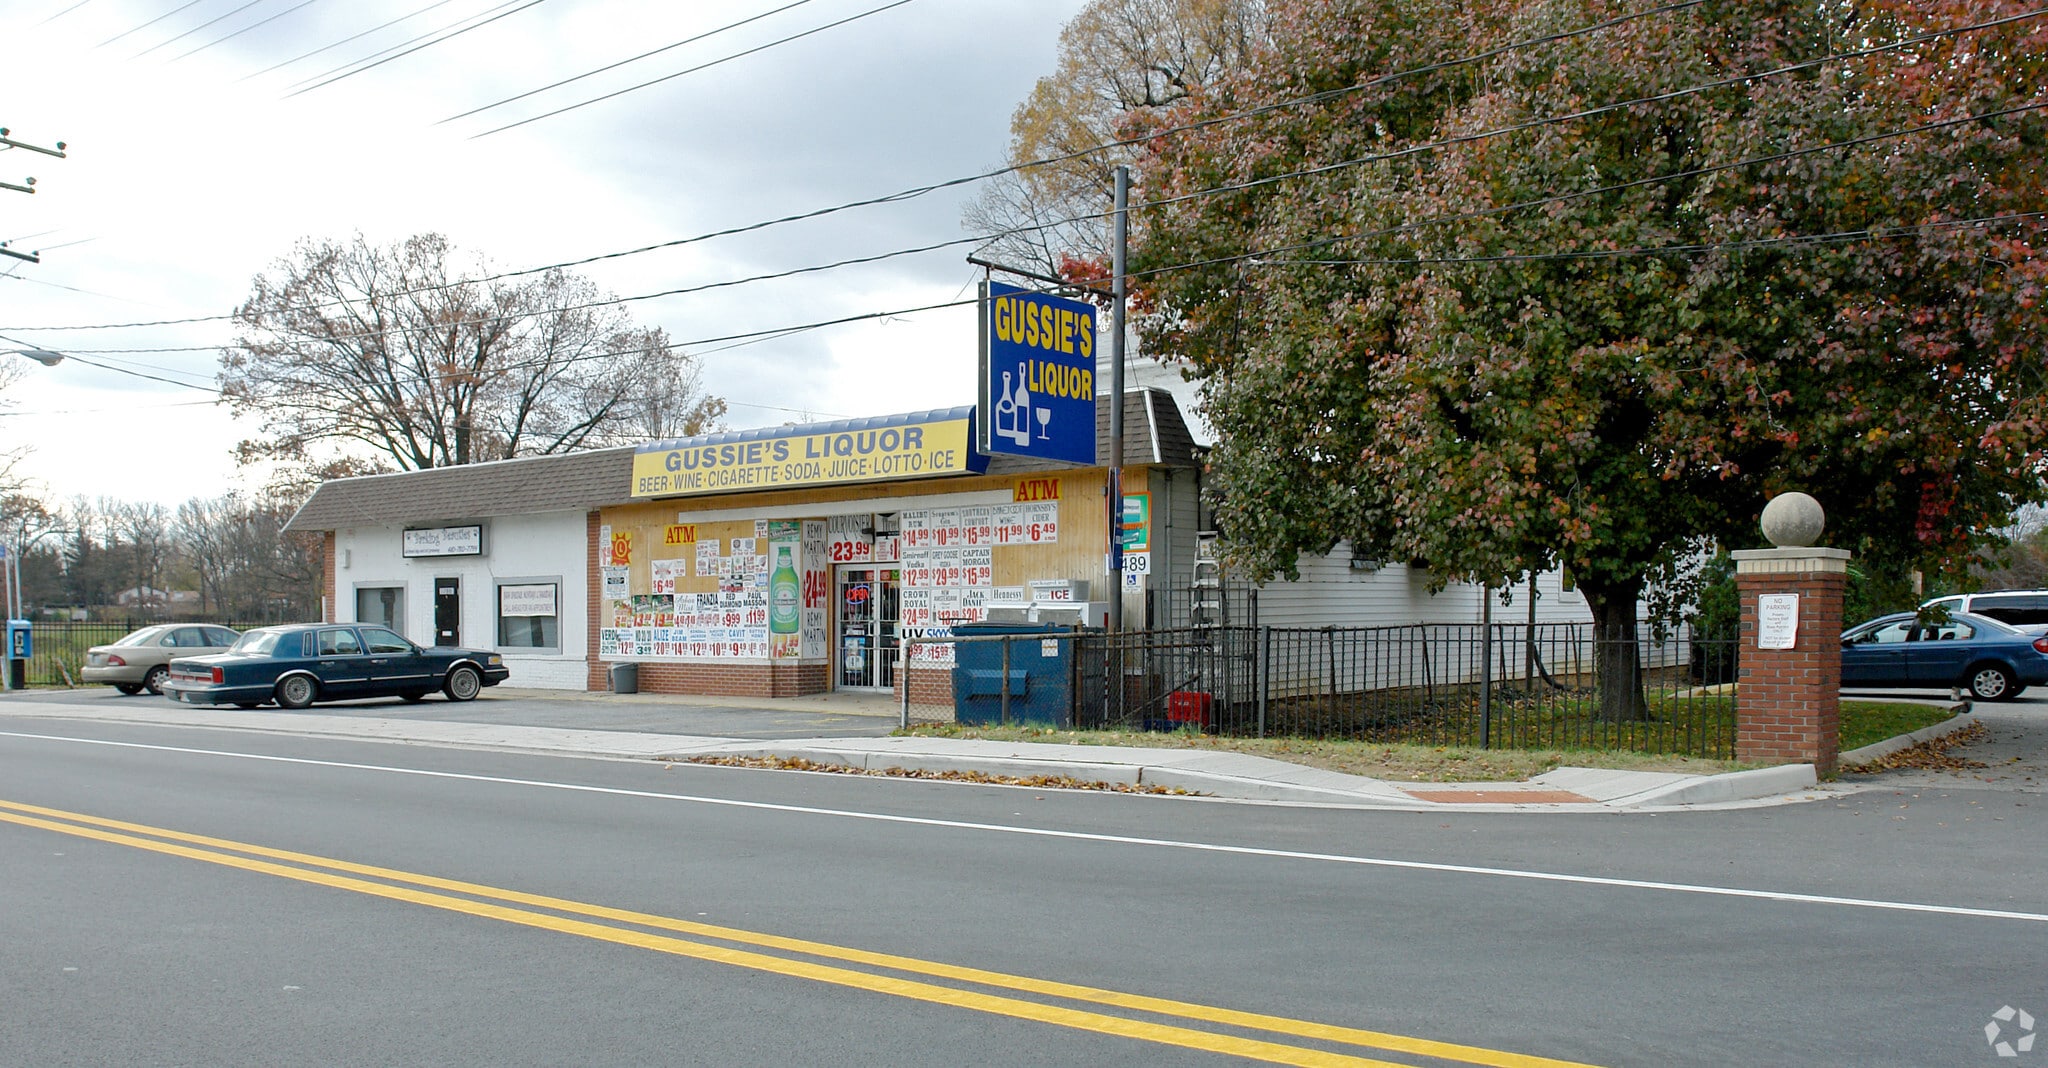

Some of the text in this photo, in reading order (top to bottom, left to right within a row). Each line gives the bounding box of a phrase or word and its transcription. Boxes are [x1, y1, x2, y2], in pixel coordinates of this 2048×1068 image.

[995, 297, 1092, 358] GUSSIE'S
[1028, 358, 1093, 402] LIQUOR
[665, 427, 924, 472] GUSSIE'S LIQUOR
[639, 450, 955, 493] BEER WINE CIGARETTE SODA JUICE LOTTO ICE
[1016, 479, 1059, 501] ATM
[903, 511, 928, 519] MALIBU
[962, 508, 990, 517] SOUTHERN
[1032, 513, 1049, 522] CIDER
[908, 520, 922, 528] RUM
[964, 517, 988, 526] COMFORT
[999, 516, 1016, 524] WINE
[665, 526, 695, 544] ATM
[807, 524, 823, 538] REMY
[903, 529, 929, 546] $14.99
[932, 527, 959, 545] $10.99
[962, 526, 990, 544] $15.99
[994, 525, 1022, 543] $11.99
[1026, 523, 1056, 541] $6.49
[804, 540, 826, 554] MARTIN
[829, 541, 870, 561] $23.99
[962, 549, 990, 557] CAPTAIN
[902, 551, 929, 559] Smirnoff
[944, 550, 959, 559] GOOSE
[962, 558, 990, 566] MORGAN
[903, 569, 929, 586] $12.99
[932, 568, 959, 586] $29.99
[962, 567, 990, 585] $15.99
[697, 594, 719, 606] FRANZIA
[846, 589, 869, 600] OPEN
[967, 590, 984, 598] JACK
[993, 589, 1022, 600] Hennessy
[1051, 589, 1069, 600] ICE
[904, 600, 927, 608] ROYAL
[807, 612, 823, 627] REMY
[903, 608, 929, 625] $24.99
[804, 628, 826, 642] MARTIN
[902, 629, 924, 639] UV
